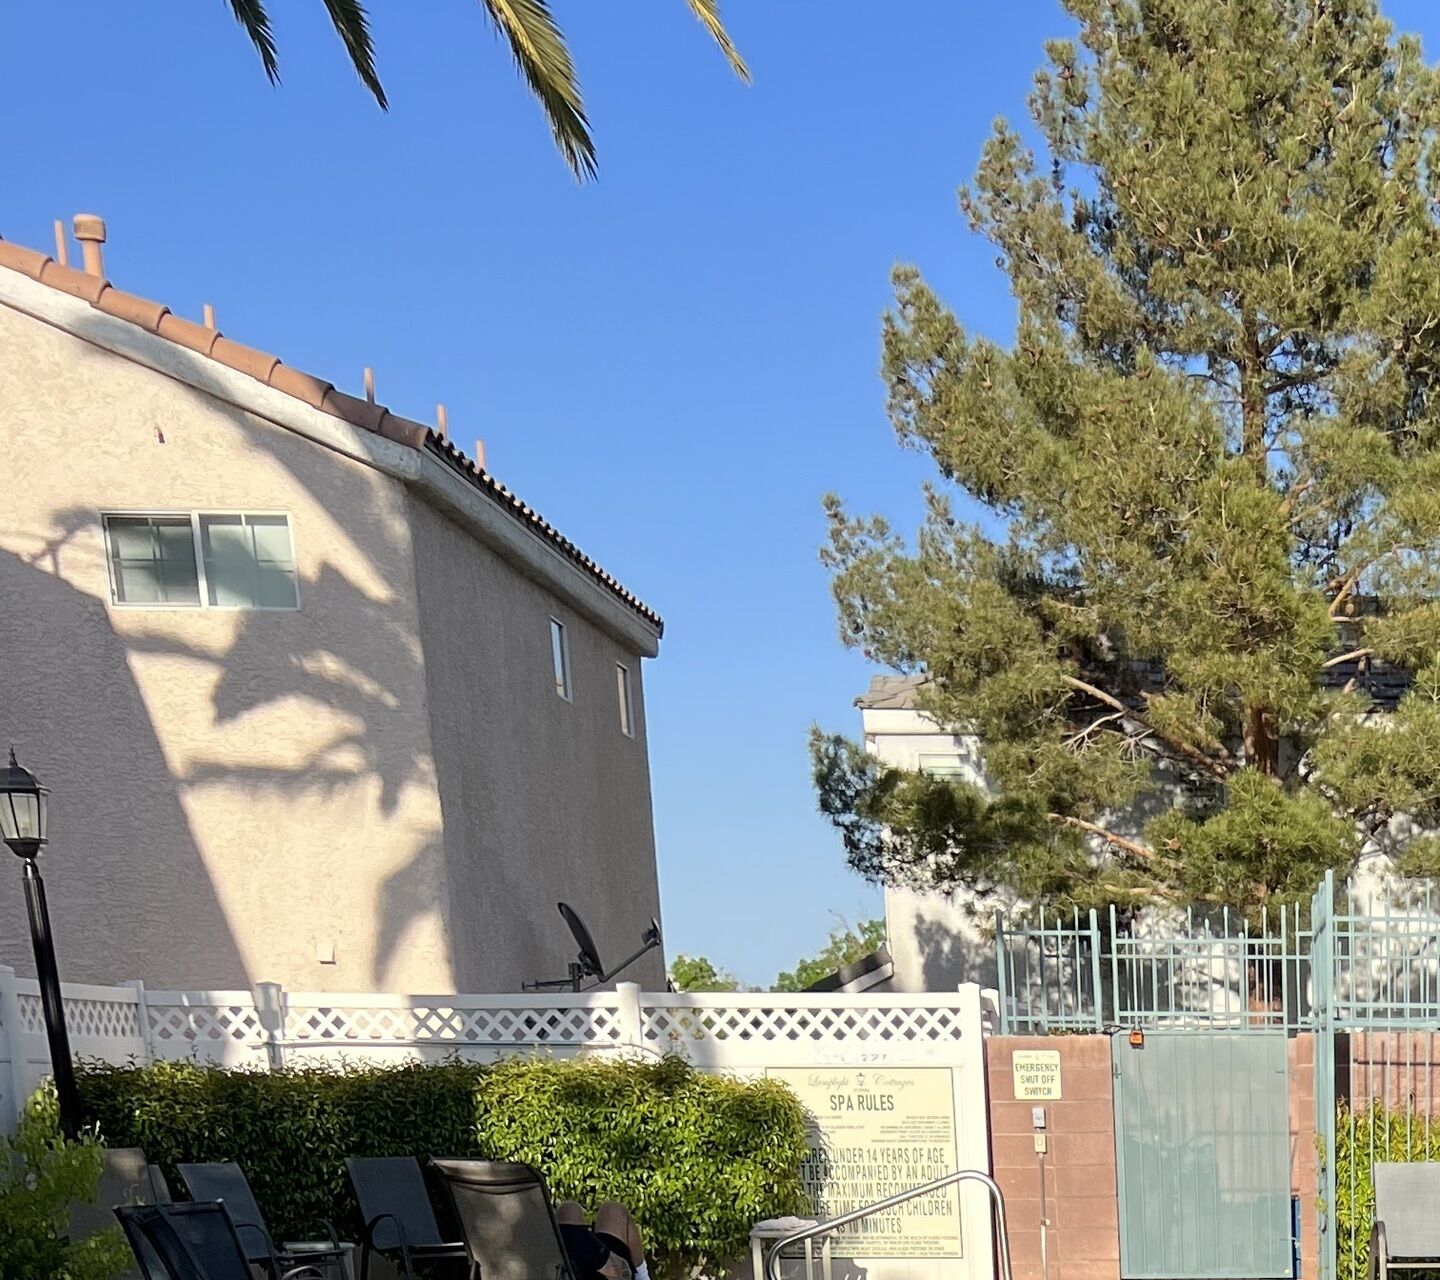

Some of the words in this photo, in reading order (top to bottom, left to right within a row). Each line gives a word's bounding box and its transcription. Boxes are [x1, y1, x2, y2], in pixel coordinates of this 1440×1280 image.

[1015, 1063, 1058, 1072] EMERGENCY
[1020, 1075, 1039, 1084] SHUT
[1041, 1075, 1055, 1084] OFF
[1024, 1087, 1052, 1096] SWITCH
[830, 1094, 854, 1111] SPA
[857, 1094, 894, 1111] RULES
[833, 1148, 864, 1164] UNDER
[866, 1148, 877, 1163] 14
[880, 1148, 910, 1164] YEARS
[912, 1147, 923, 1164] OF
[927, 1147, 945, 1164] AGE
[809, 1165, 820, 1180] BE
[891, 1165, 902, 1180] BY
[906, 1165, 918, 1180] AN
[921, 1165, 949, 1181] ADULT
[828, 1182, 874, 1198] MAXIMUM
[834, 1200, 855, 1216] TIME
[906, 1200, 952, 1216] CHILDREN
[861, 1218, 902, 1233] MINUTES
